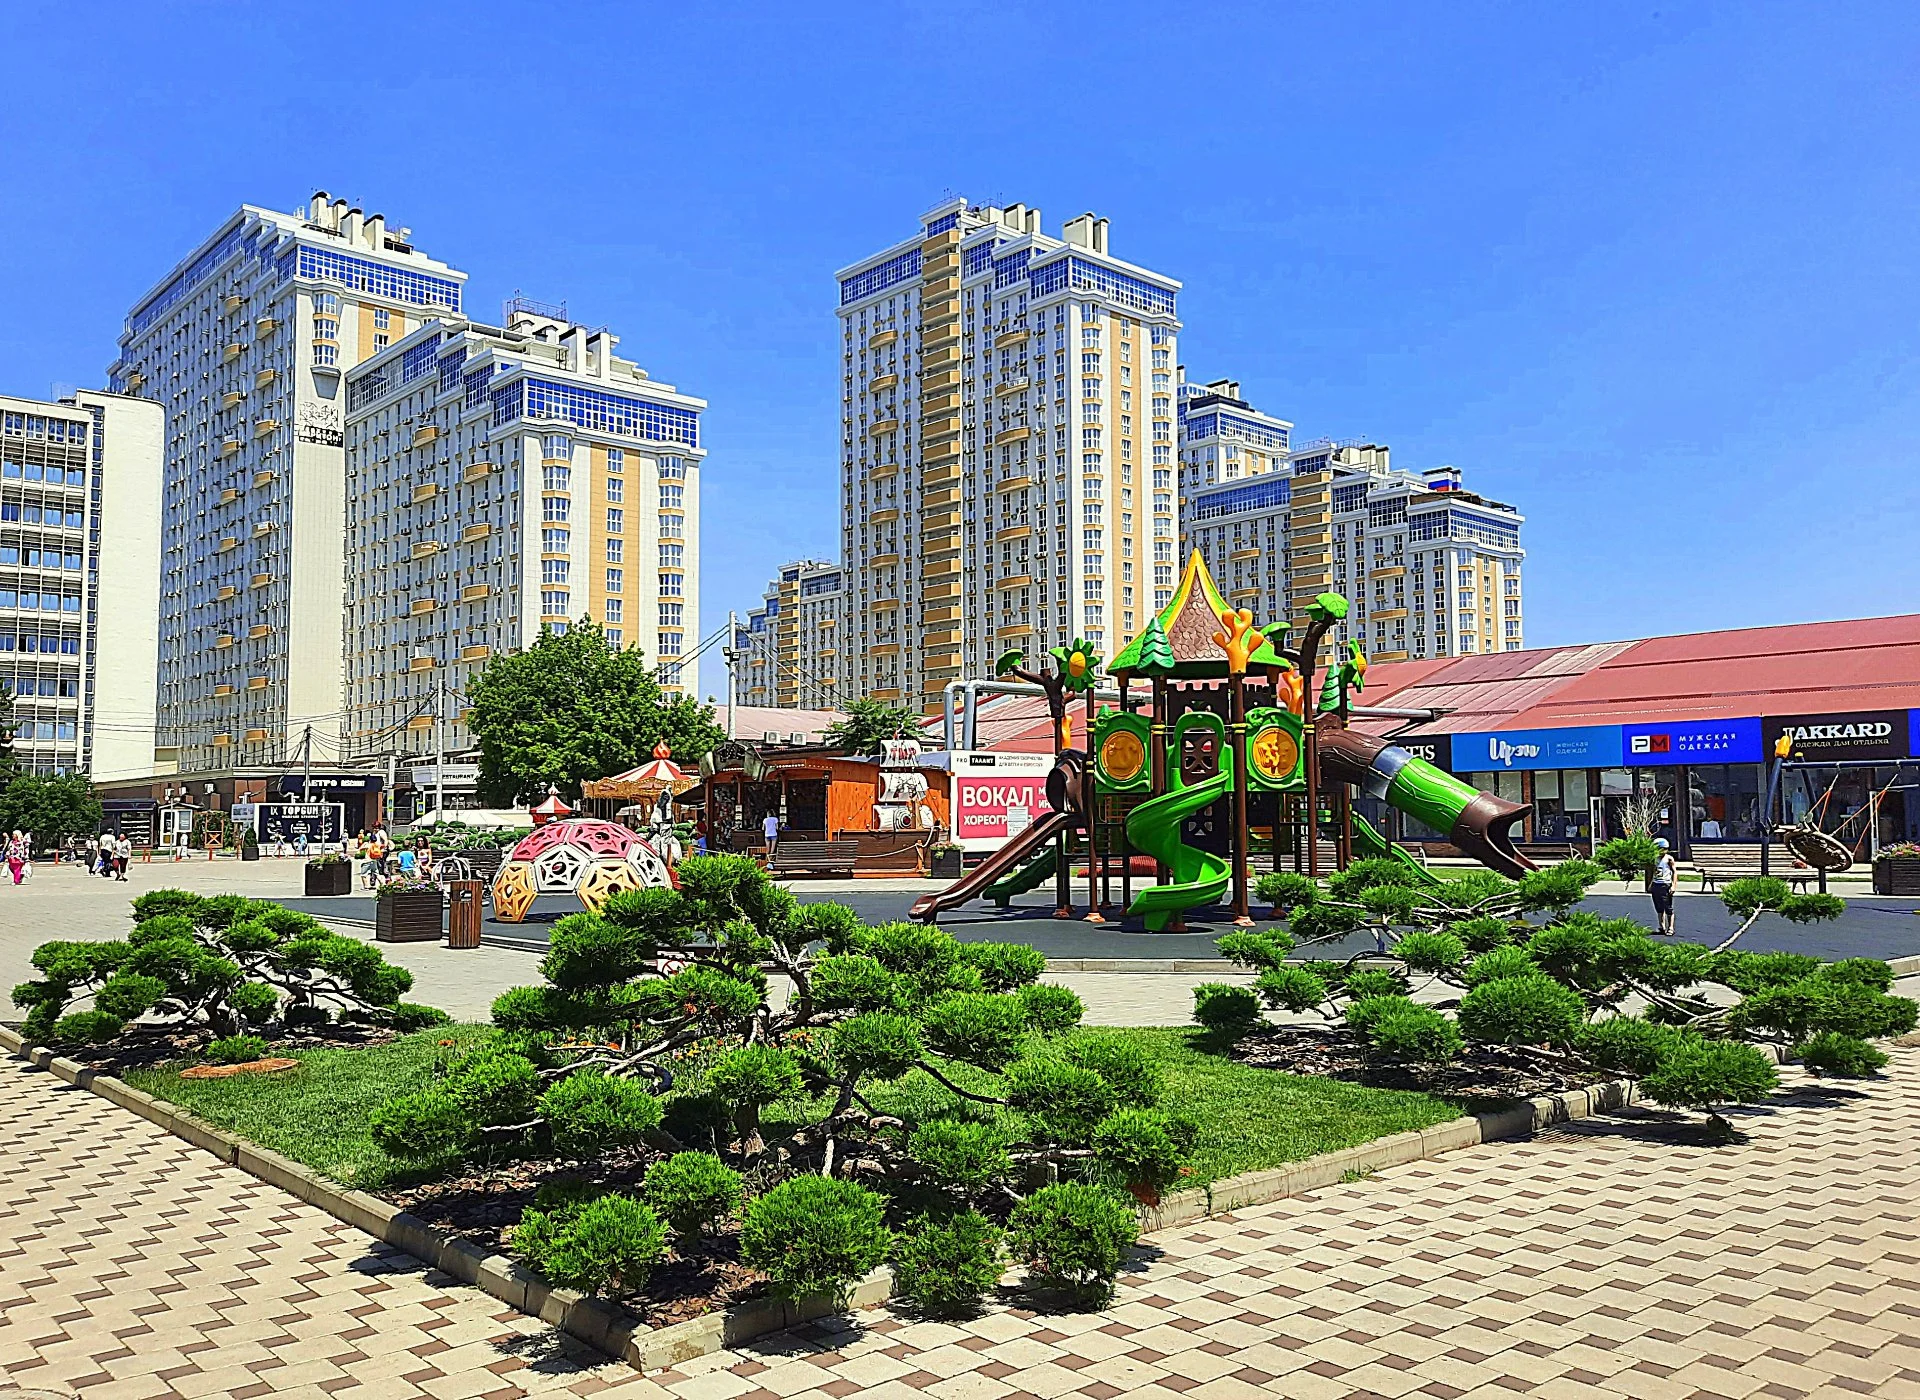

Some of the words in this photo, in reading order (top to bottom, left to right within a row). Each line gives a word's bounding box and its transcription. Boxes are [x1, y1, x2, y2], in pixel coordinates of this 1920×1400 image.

[1678, 733, 1736, 742] МУЖСКАЯ
[1775, 722, 1892, 747] JAKKARD
[1678, 742, 1729, 751] ОДЕЖДА
[1795, 740, 1831, 748] одежда
[1853, 738, 1890, 746] отдыха
[962, 786, 1034, 807] ВОКАЛ
[282, 806, 319, 815] TOPGUN
[963, 815, 1034, 826] ХОРЕОГРЯ
